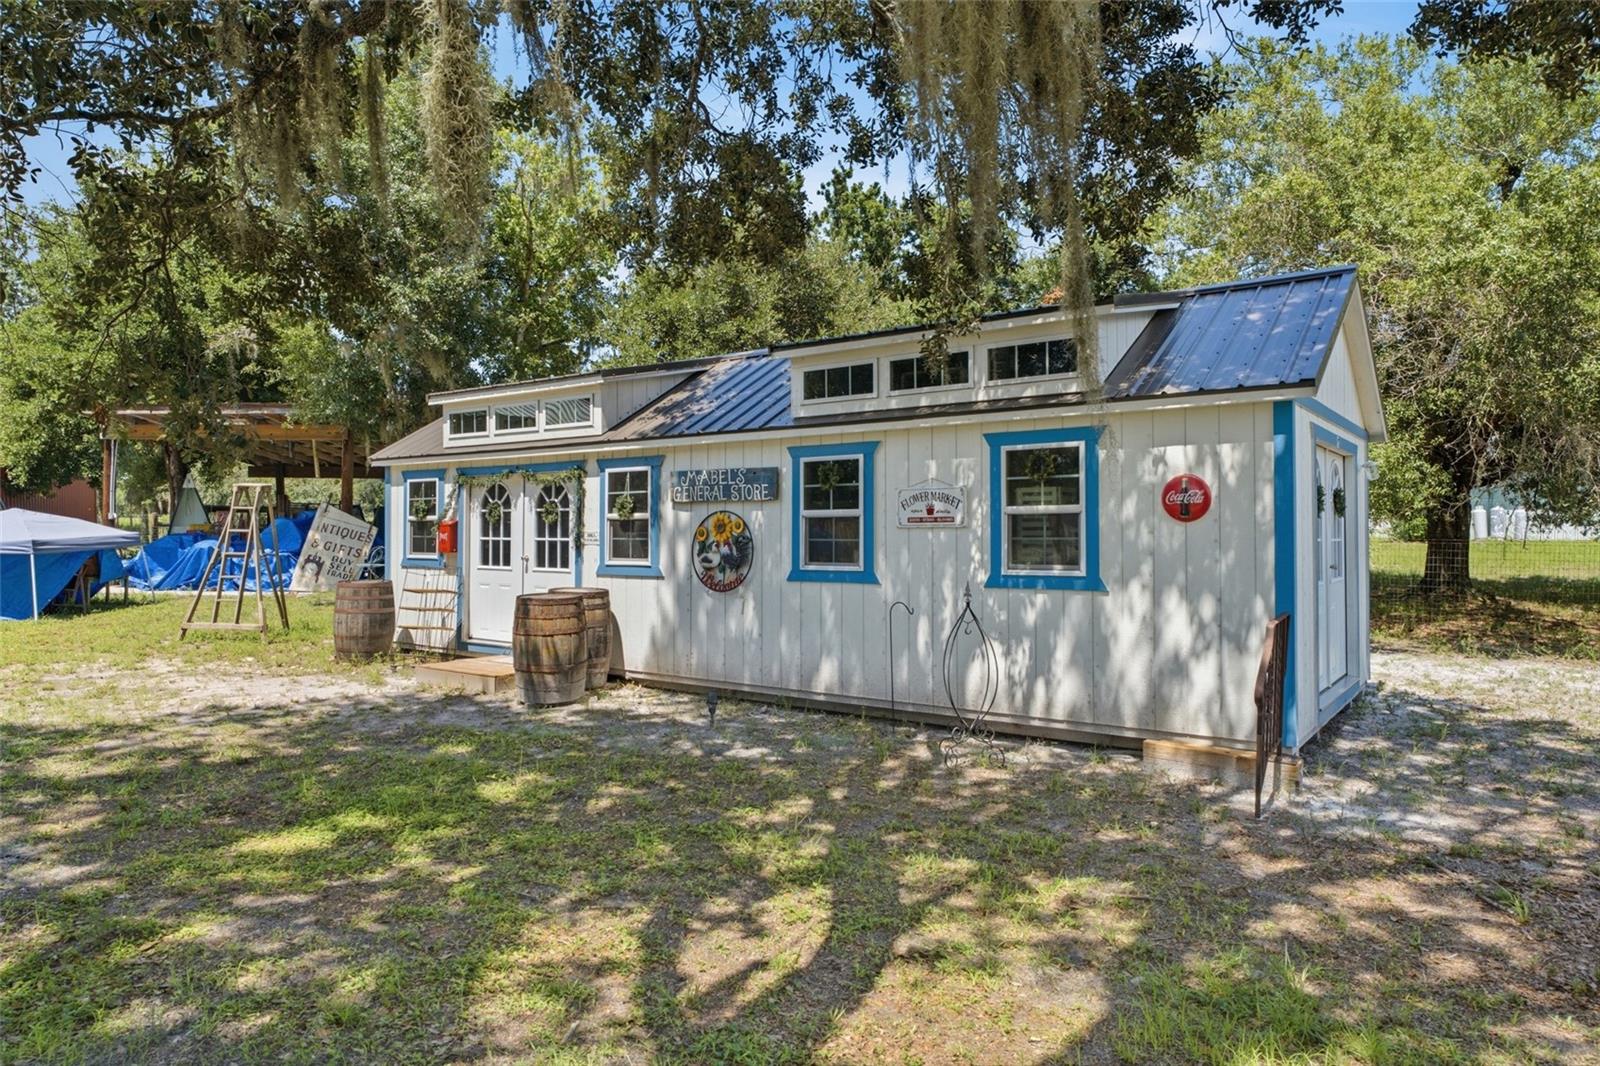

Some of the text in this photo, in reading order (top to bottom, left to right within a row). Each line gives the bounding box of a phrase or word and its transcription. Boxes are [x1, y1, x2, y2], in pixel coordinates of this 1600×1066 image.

[680, 468, 746, 486] MABEL'S
[673, 484, 769, 502] GENERAL STORE
[900, 491, 962, 511] FLOWER MARKET
[1165, 489, 1205, 505] Coca-Cola
[318, 522, 374, 544] NTIQUES
[323, 540, 364, 559] GIFTS
[331, 555, 354, 566] BUY
